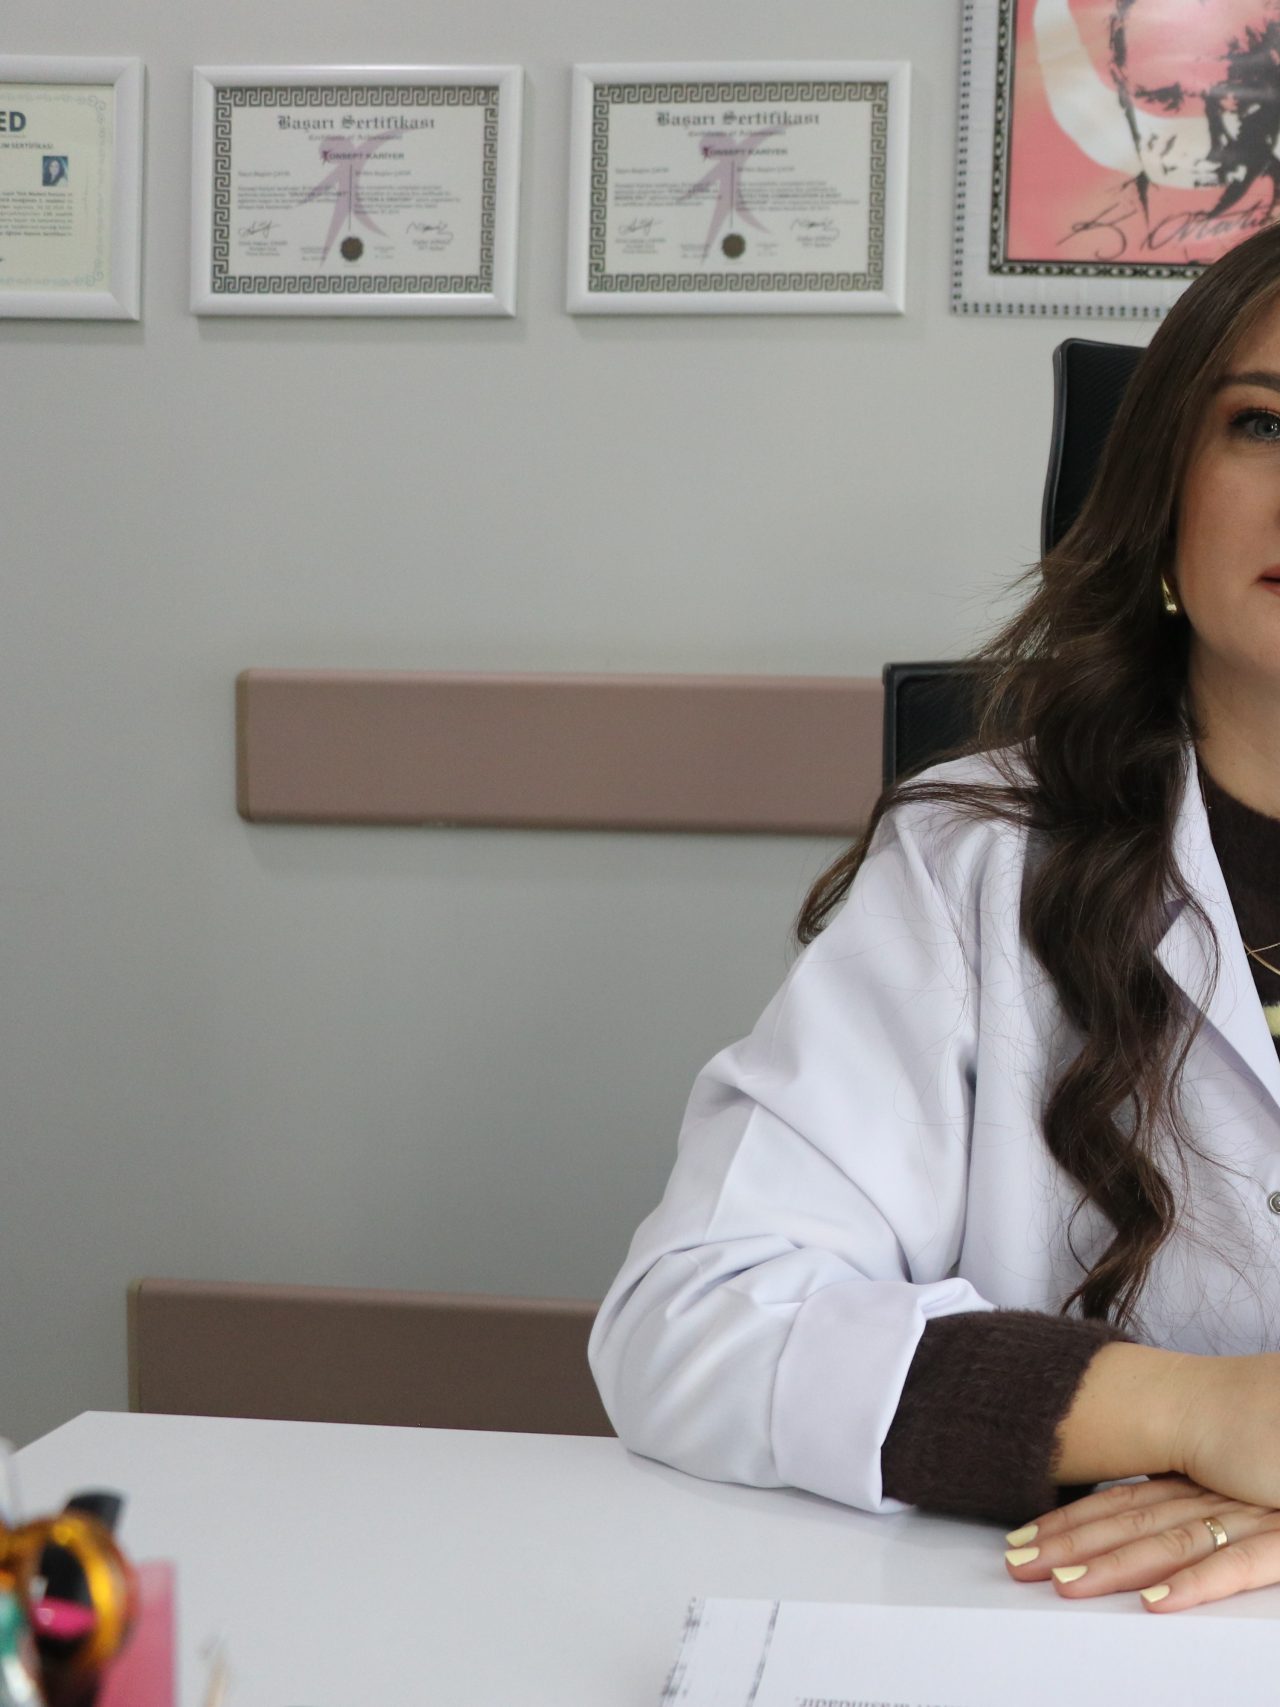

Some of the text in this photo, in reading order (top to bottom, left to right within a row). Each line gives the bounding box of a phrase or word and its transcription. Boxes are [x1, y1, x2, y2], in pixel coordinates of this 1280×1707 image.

[277, 114, 436, 133] Başarı Sertifikası
[656, 110, 821, 130] Başarı Sertifikası
